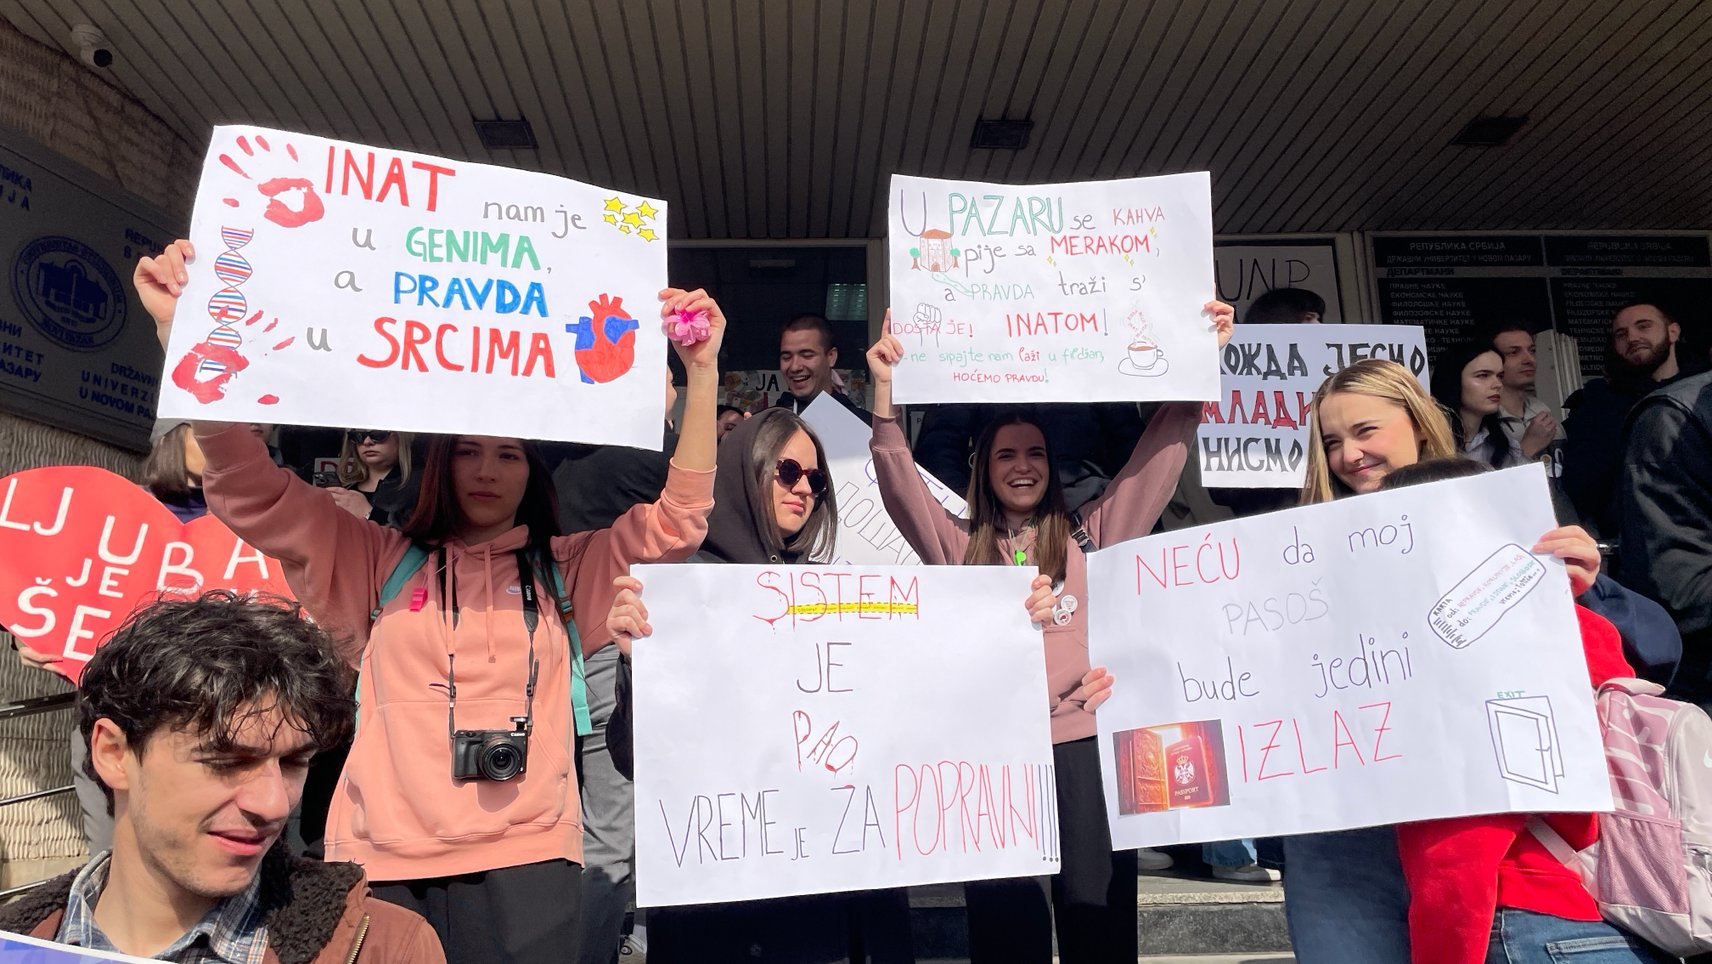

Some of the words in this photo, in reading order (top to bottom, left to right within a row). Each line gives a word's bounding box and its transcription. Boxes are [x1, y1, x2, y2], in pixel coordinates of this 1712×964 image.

[325, 145, 456, 212] INAT
[483, 201, 545, 223] nam
[551, 203, 586, 239] je
[901, 189, 926, 236] U
[948, 193, 1064, 237] PAZARU
[1070, 213, 1096, 230] se
[1113, 205, 1165, 225] KAHVA
[352, 226, 377, 251] u
[406, 226, 552, 273] GENIMA,
[965, 244, 1006, 277] pije
[1015, 245, 1036, 257] sa
[1409, 242, 1466, 251] РЕПУБЛИКА
[1468, 241, 1506, 250] СРБИЈА
[334, 269, 362, 293] a
[394, 272, 548, 318] PRAVDA
[944, 288, 956, 301] a
[970, 283, 1035, 300] PRAVDA
[1058, 270, 1107, 296] traži
[1006, 308, 1108, 338] INATOM!
[306, 326, 333, 352] u
[356, 316, 556, 379] SRCIMA
[939, 346, 984, 367] sipajte
[988, 351, 1014, 362] nam
[1018, 346, 1040, 362] laži
[1048, 352, 1056, 361] u
[1220, 343, 1308, 380] ОЖДА
[953, 369, 1001, 384] HOĆEMO
[1004, 366, 1049, 383] PRAVDU!
[91, 390, 135, 414] NOVOM
[1202, 437, 1303, 472] НИСМО
[1135, 532, 1242, 595] NEĆU
[1283, 527, 1316, 566] da
[1347, 513, 1415, 555] moj
[66, 558, 129, 598] JE
[752, 571, 920, 630] SISTEM
[1223, 576, 1329, 635] PASOŠ
[796, 642, 854, 693] JE
[1177, 656, 1260, 702] bude
[1311, 631, 1414, 699] jedini
[1497, 689, 1526, 699] EXIT
[792, 710, 858, 773] PAO
[1237, 701, 1403, 783] IZLAZ
[658, 789, 784, 868] VREME
[791, 827, 809, 861] JE
[830, 784, 886, 855] ZA
